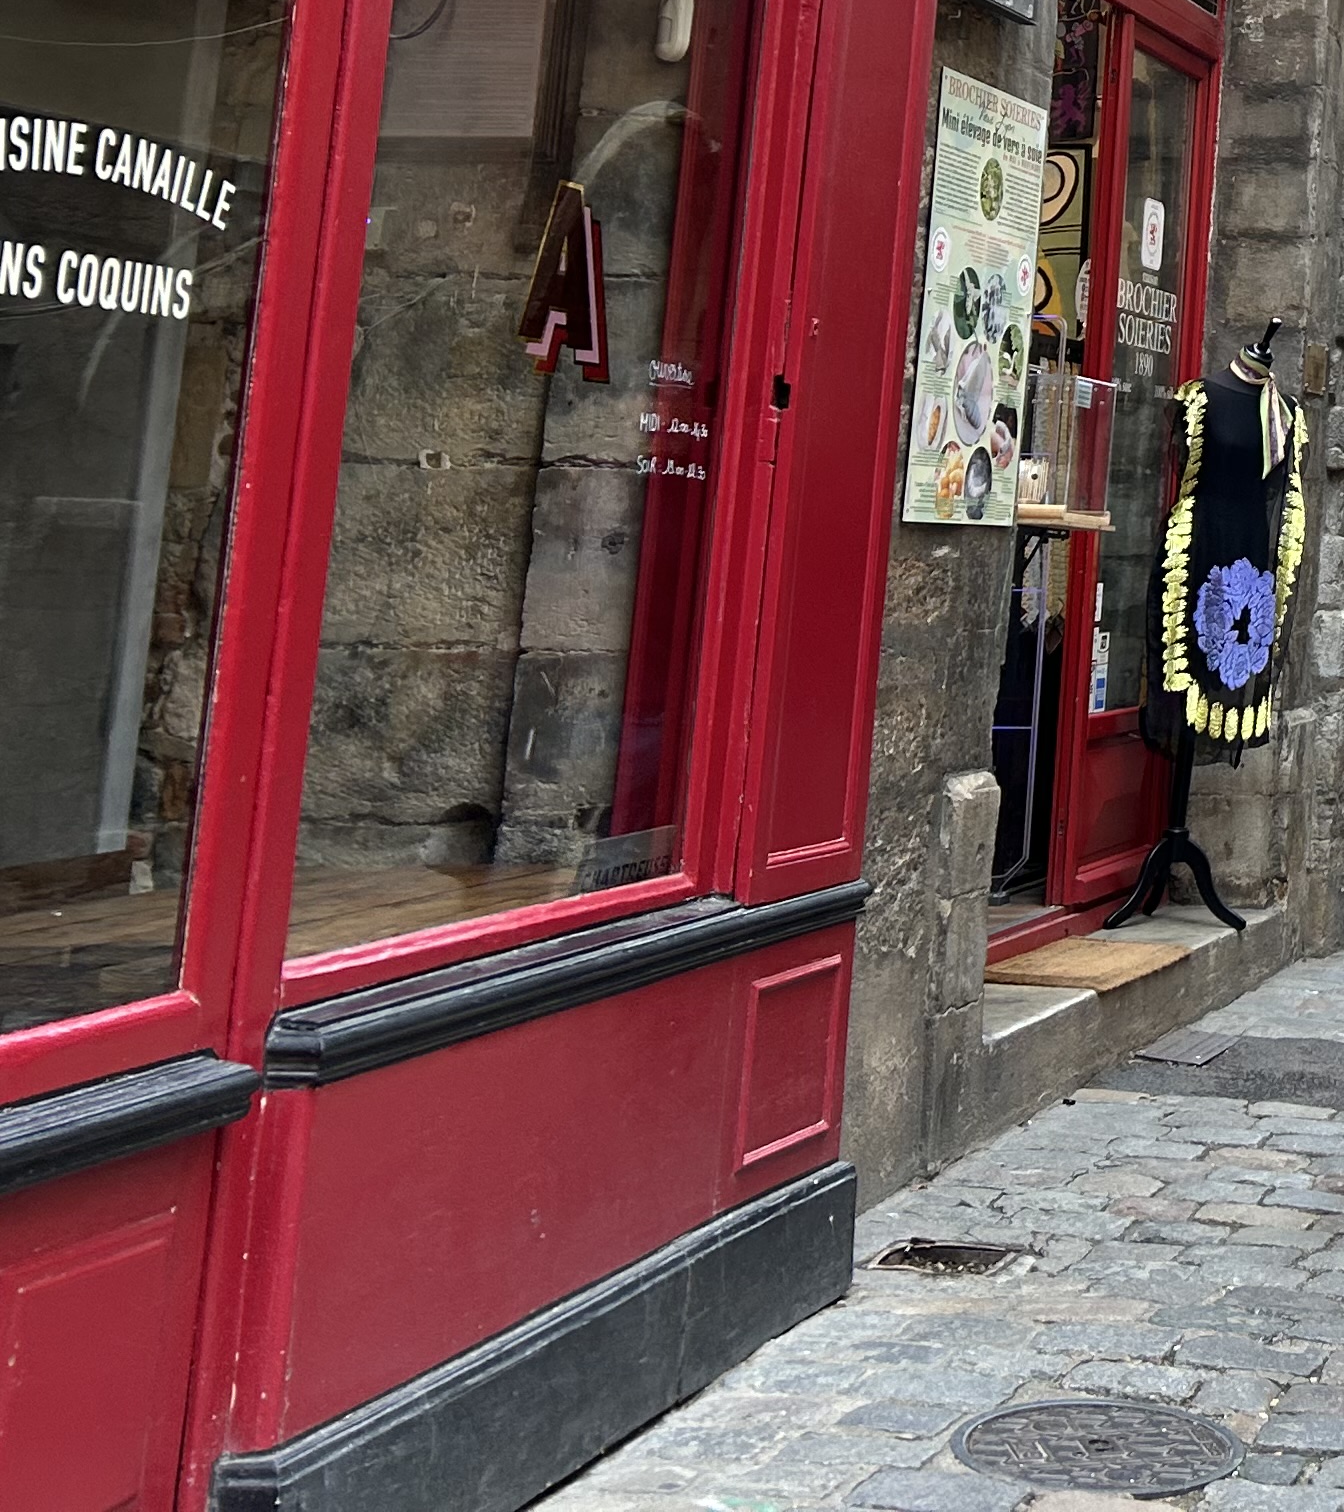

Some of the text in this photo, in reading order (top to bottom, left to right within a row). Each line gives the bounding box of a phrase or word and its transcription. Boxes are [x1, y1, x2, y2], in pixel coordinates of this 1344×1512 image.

[948, 75, 1041, 132] BROCHIER SOIERIES
[941, 106, 1043, 164] Mini élevage de vers à soie
[95, 128, 236, 231] CANAILLE
[0, 241, 193, 320] NS COQUINS
[518, 180, 610, 384] A
[1116, 278, 1177, 323] BROCHIER
[1117, 312, 1172, 356] SOIERIES
[1134, 352, 1154, 377] 1890
[640, 412, 660, 433] MIDI
[636, 454, 657, 475] SOIR
